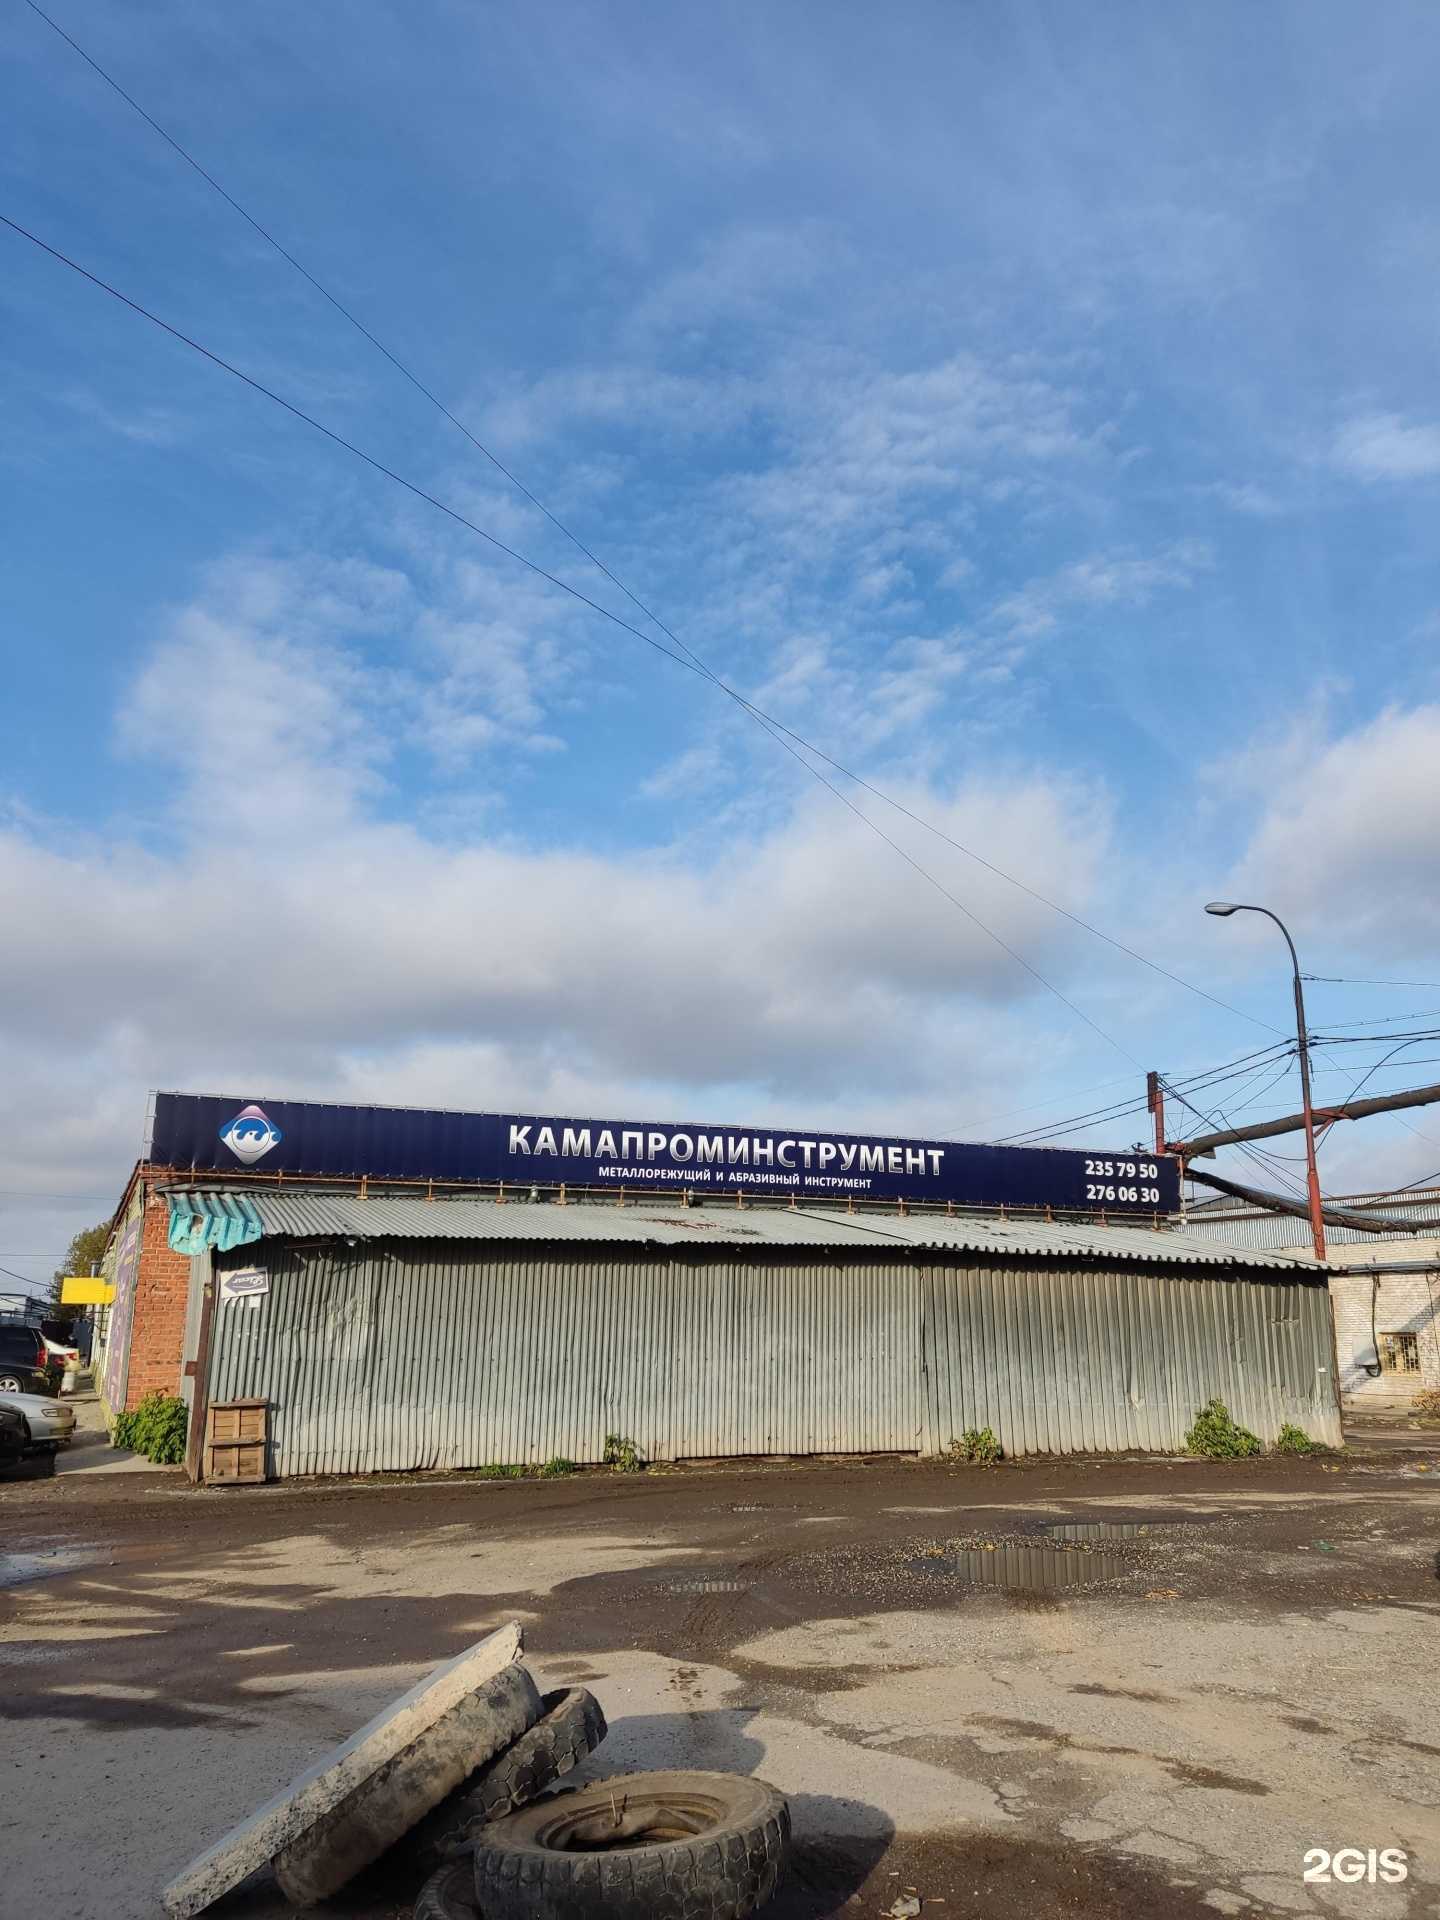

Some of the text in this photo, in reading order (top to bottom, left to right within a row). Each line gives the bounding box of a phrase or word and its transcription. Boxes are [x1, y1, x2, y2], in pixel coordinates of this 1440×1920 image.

[509, 1125, 945, 1176] КАМАПРОМИНСТРУМЕНТ
[599, 1166, 872, 1189] МЕТАЛЛОРЕЖУЩИЙ И АБРАЗИВНЫЙ ИНСТРУМЕНТ
[1085, 1160, 1158, 1179] 235 79 50
[1086, 1184, 1160, 1203] 276 06 30
